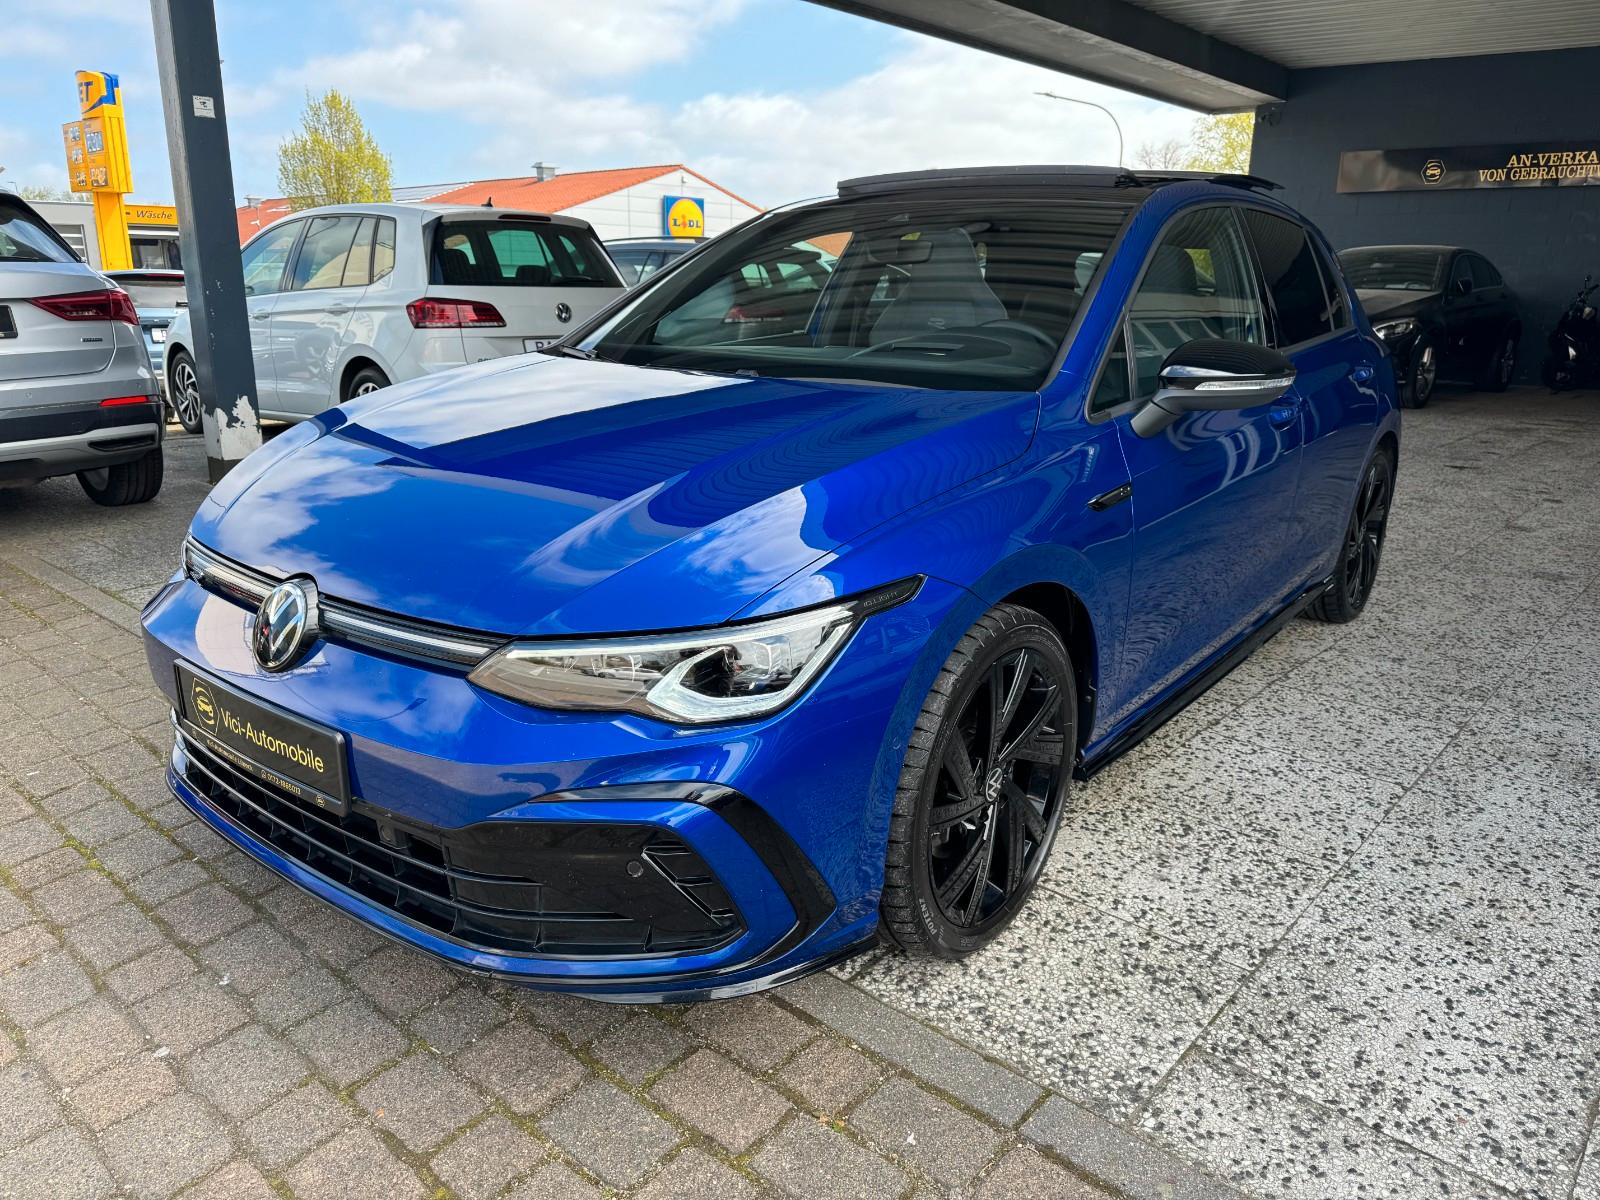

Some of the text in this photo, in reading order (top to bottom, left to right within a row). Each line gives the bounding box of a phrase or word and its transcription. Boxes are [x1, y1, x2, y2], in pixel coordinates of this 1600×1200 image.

[1506, 150, 1600, 168] AN-VERKA
[1479, 168, 1507, 182] VON
[136, 209, 173, 220] Wäsche
[220, 707, 324, 773] Vici-Automobile
